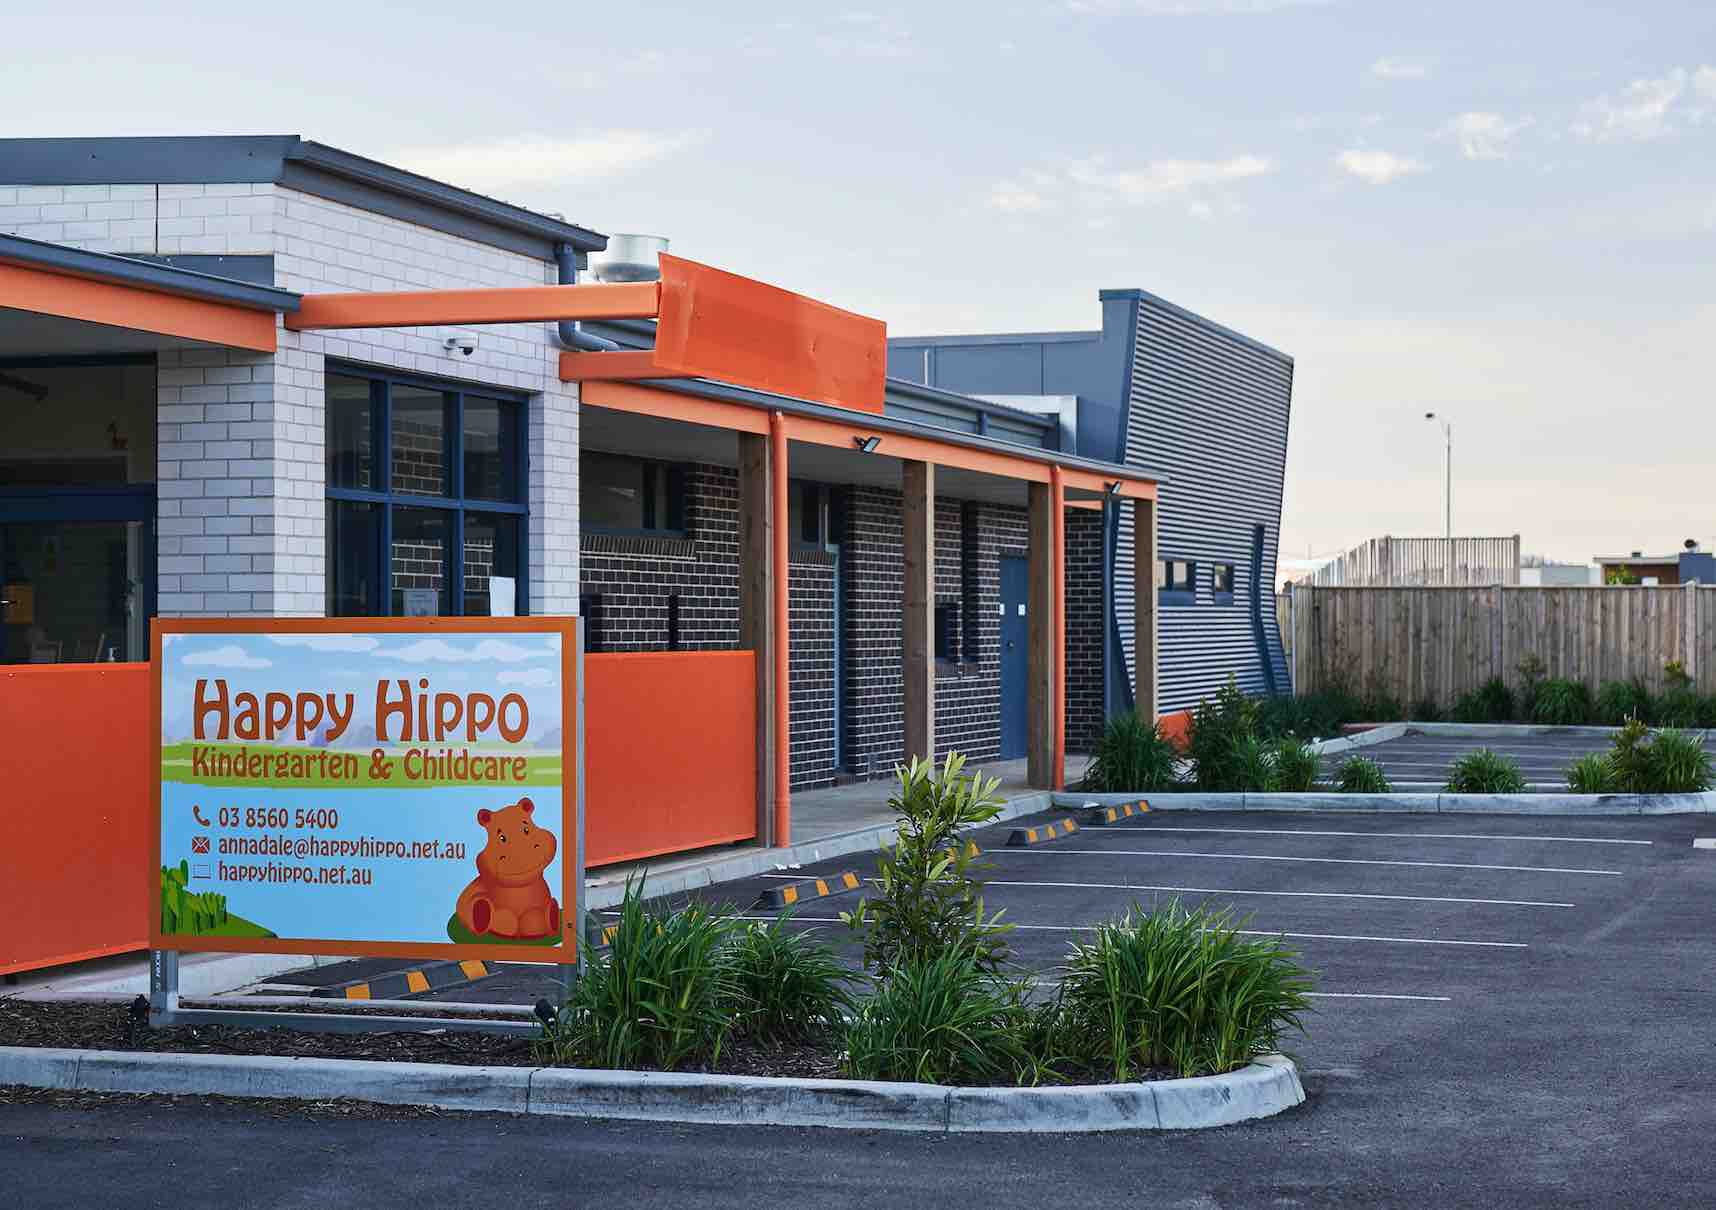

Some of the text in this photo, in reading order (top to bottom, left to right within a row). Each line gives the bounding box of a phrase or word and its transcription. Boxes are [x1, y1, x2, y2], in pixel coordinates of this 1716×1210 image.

[193, 678, 529, 743] Happy Hippo
[192, 747, 527, 781] Kindergarten & Childcare
[218, 807, 339, 829] 03 8560 5400
[218, 834, 466, 860] annadale@happyhippo.net.au
[218, 860, 372, 886] happyhippo.net.au
